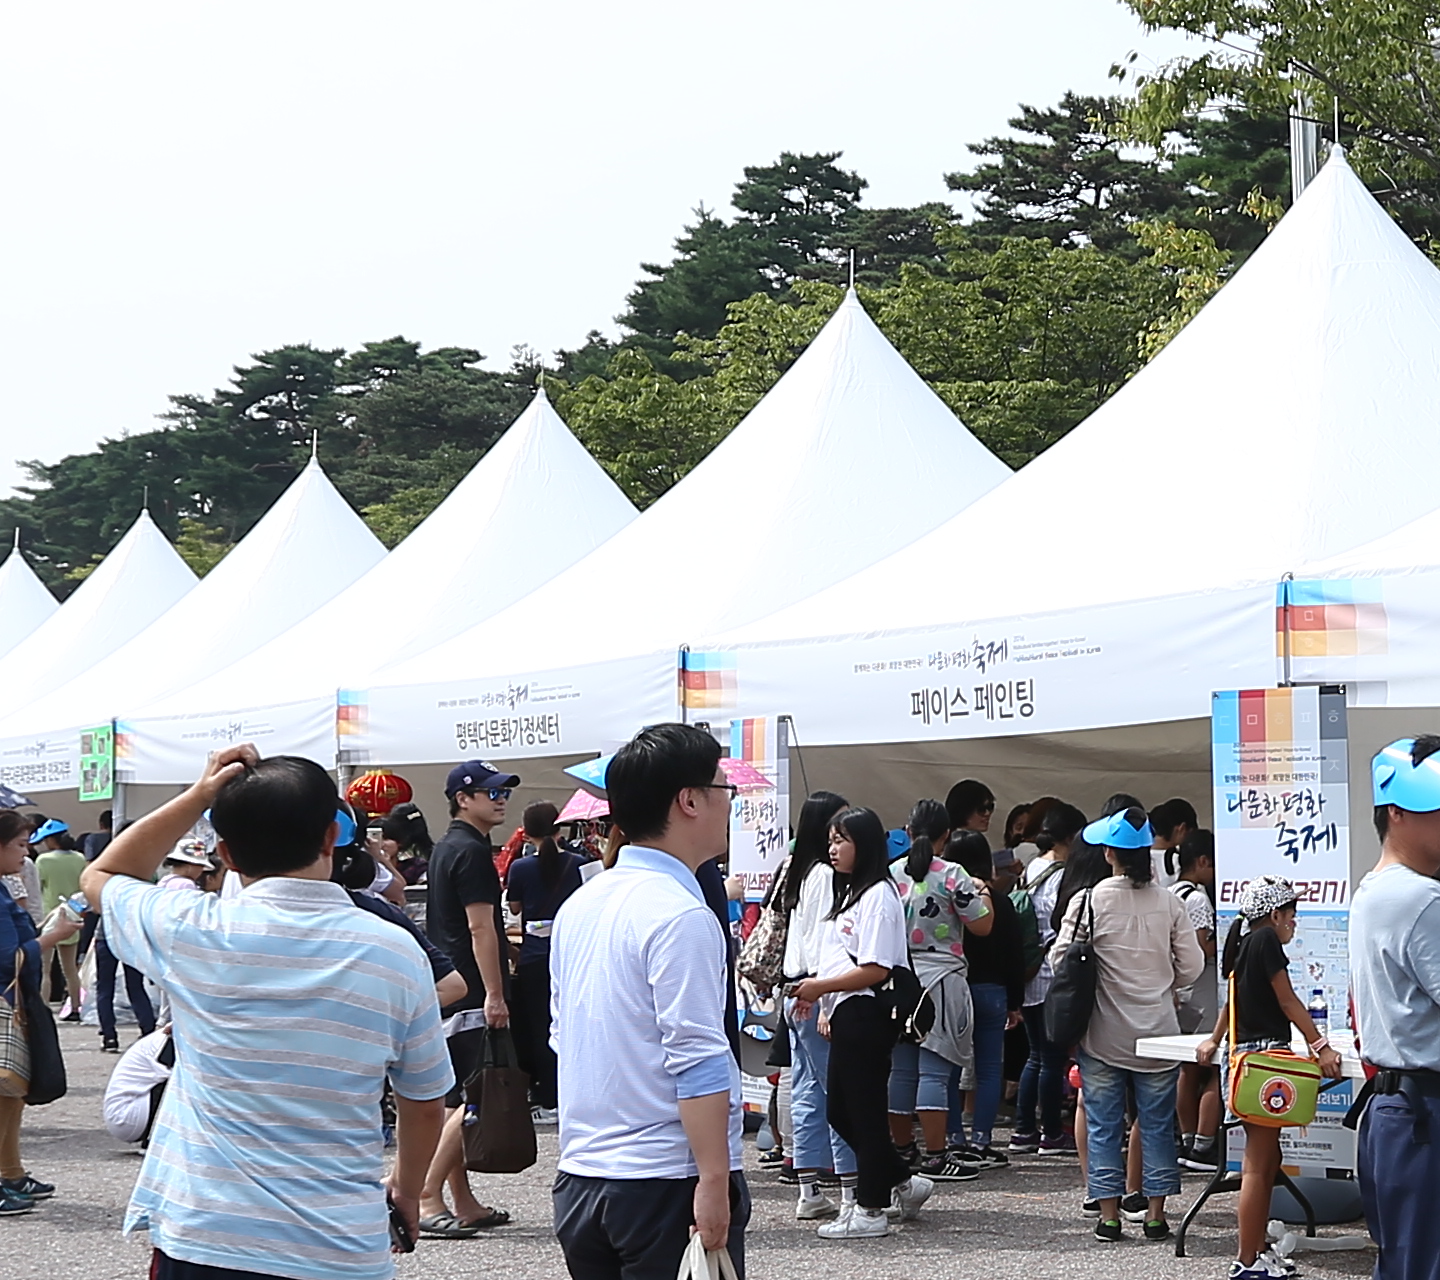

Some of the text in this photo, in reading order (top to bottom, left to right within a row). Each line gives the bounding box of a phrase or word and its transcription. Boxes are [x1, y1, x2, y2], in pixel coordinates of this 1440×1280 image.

[972, 634, 1009, 674] 축제
[911, 678, 1034, 725] 페이스 페인팅
[456, 713, 560, 750] 평택다문화가정센터
[755, 820, 783, 859] 축제
[1274, 814, 1338, 864] 축제
